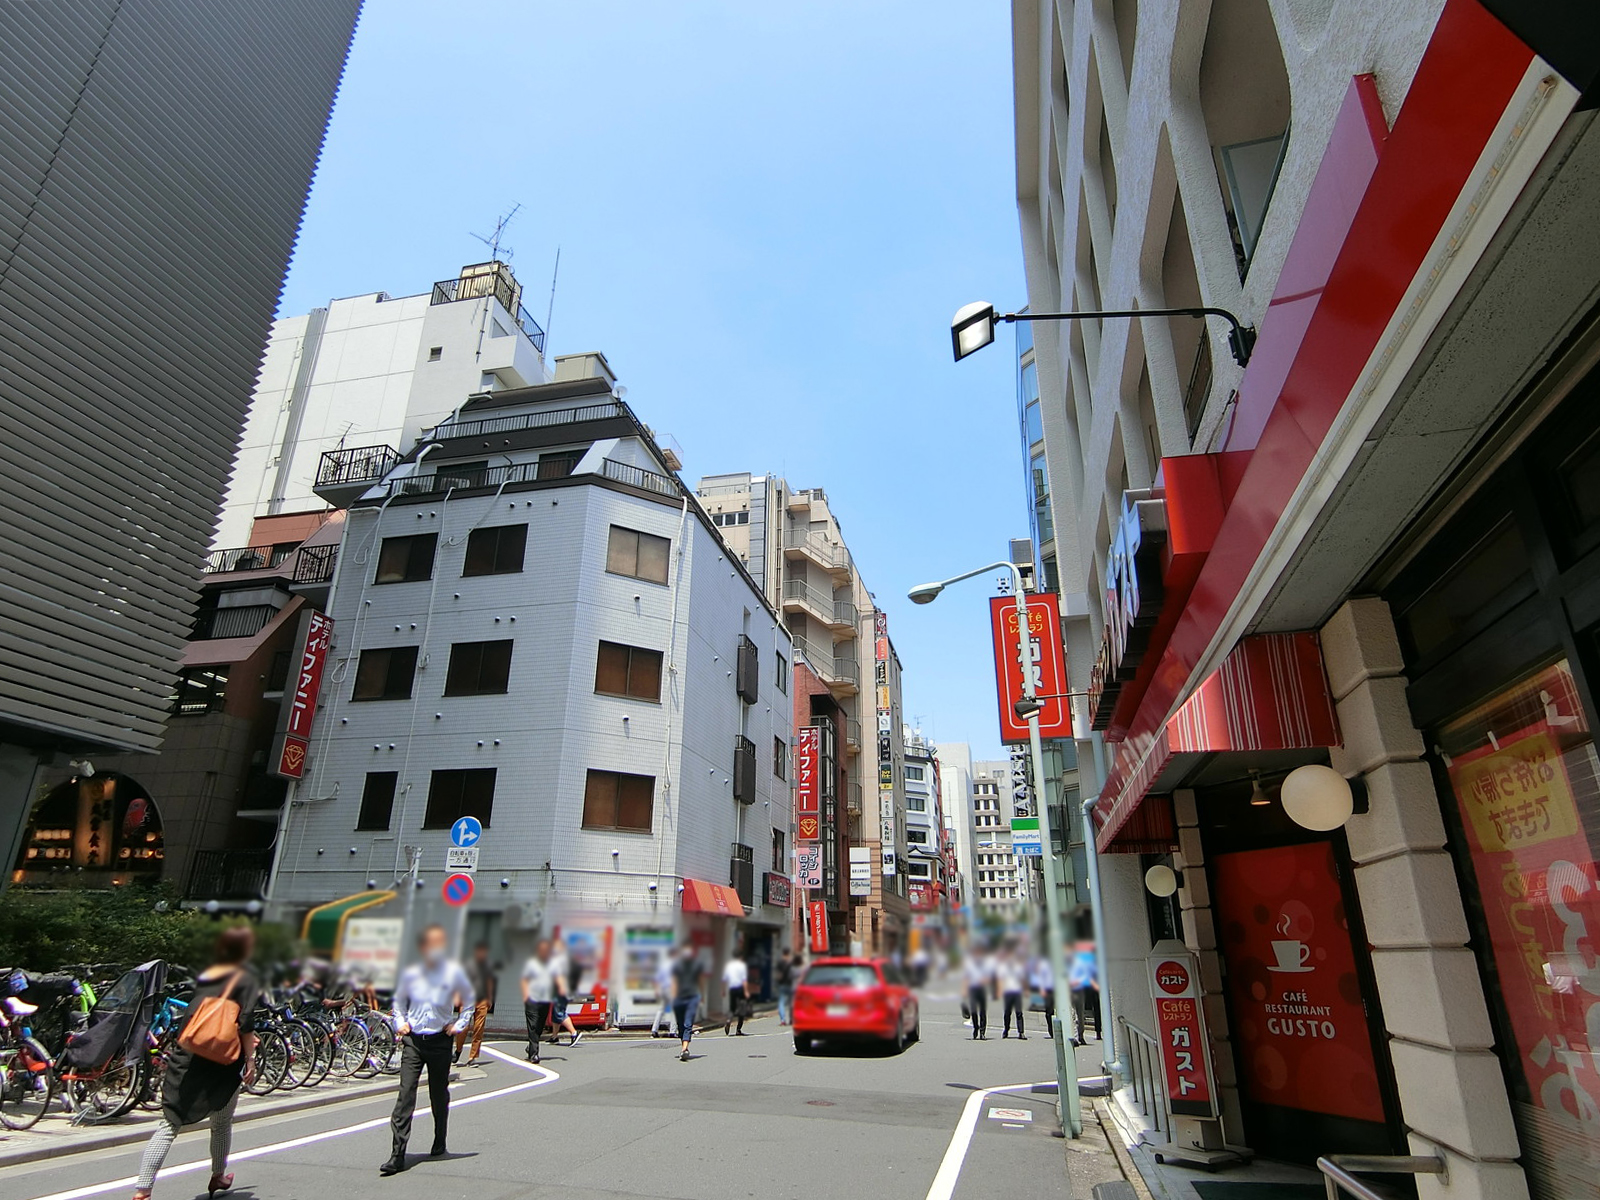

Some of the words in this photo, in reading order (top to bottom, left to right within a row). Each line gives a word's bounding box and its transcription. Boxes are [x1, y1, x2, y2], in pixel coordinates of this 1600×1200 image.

[1008, 612, 1042, 624] Cfé
[318, 619, 334, 650] ホテル
[293, 614, 324, 731] ティファニー
[810, 728, 819, 750] ホテル
[799, 729, 811, 811] ティファニー
[808, 847, 819, 870] コイン
[799, 855, 809, 885] ロッカー
[1161, 975, 1186, 985] ガスト
[1162, 1000, 1191, 1012] Café
[1282, 988, 1308, 1003] CAFÉ
[1163, 1012, 1192, 1021] レストラン
[1264, 1003, 1331, 1016] RESTAURANT
[1267, 1017, 1336, 1040] GUSTO
[1171, 1026, 1196, 1096] ガスト
